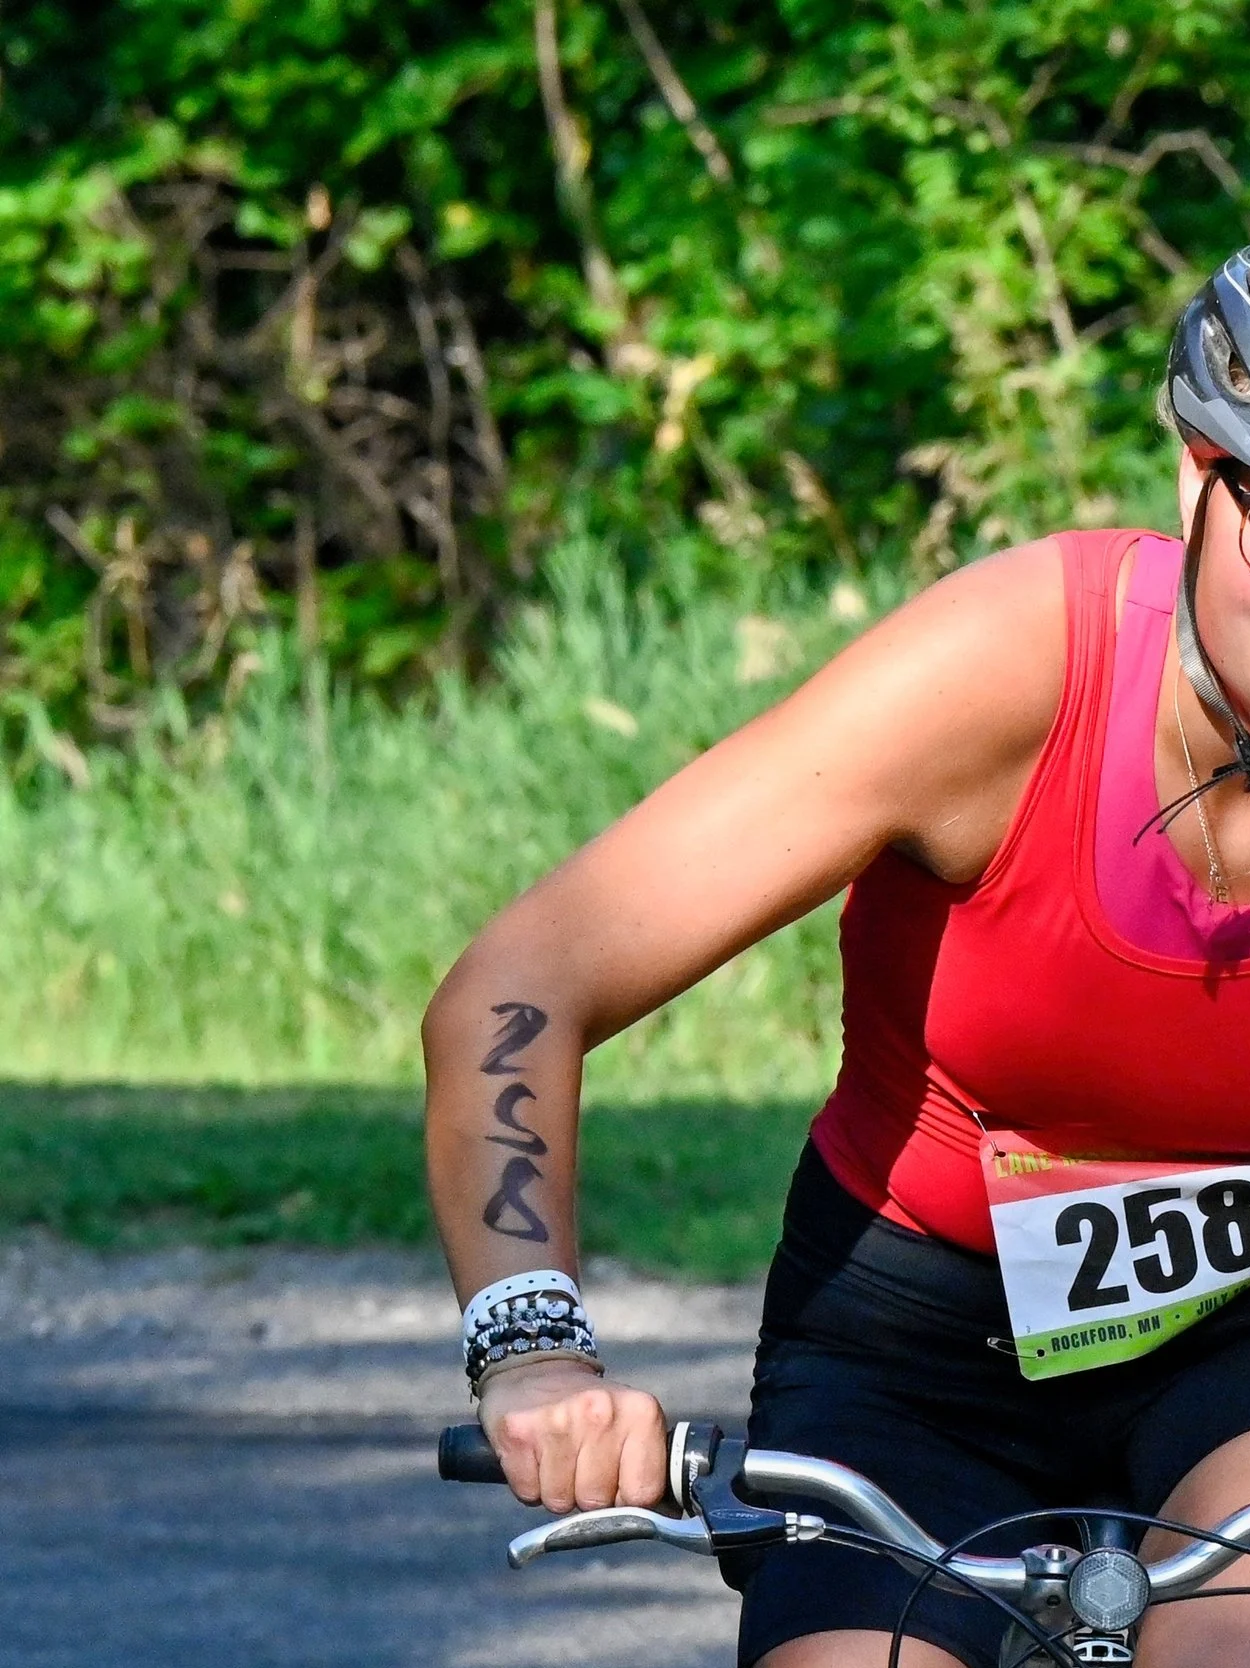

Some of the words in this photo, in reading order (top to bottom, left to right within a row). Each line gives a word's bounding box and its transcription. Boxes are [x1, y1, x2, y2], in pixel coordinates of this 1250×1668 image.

[480, 1001, 549, 1244] 258
[1051, 1322, 1134, 1354] ROCKFORD,
[1138, 1315, 1161, 1333] MN
